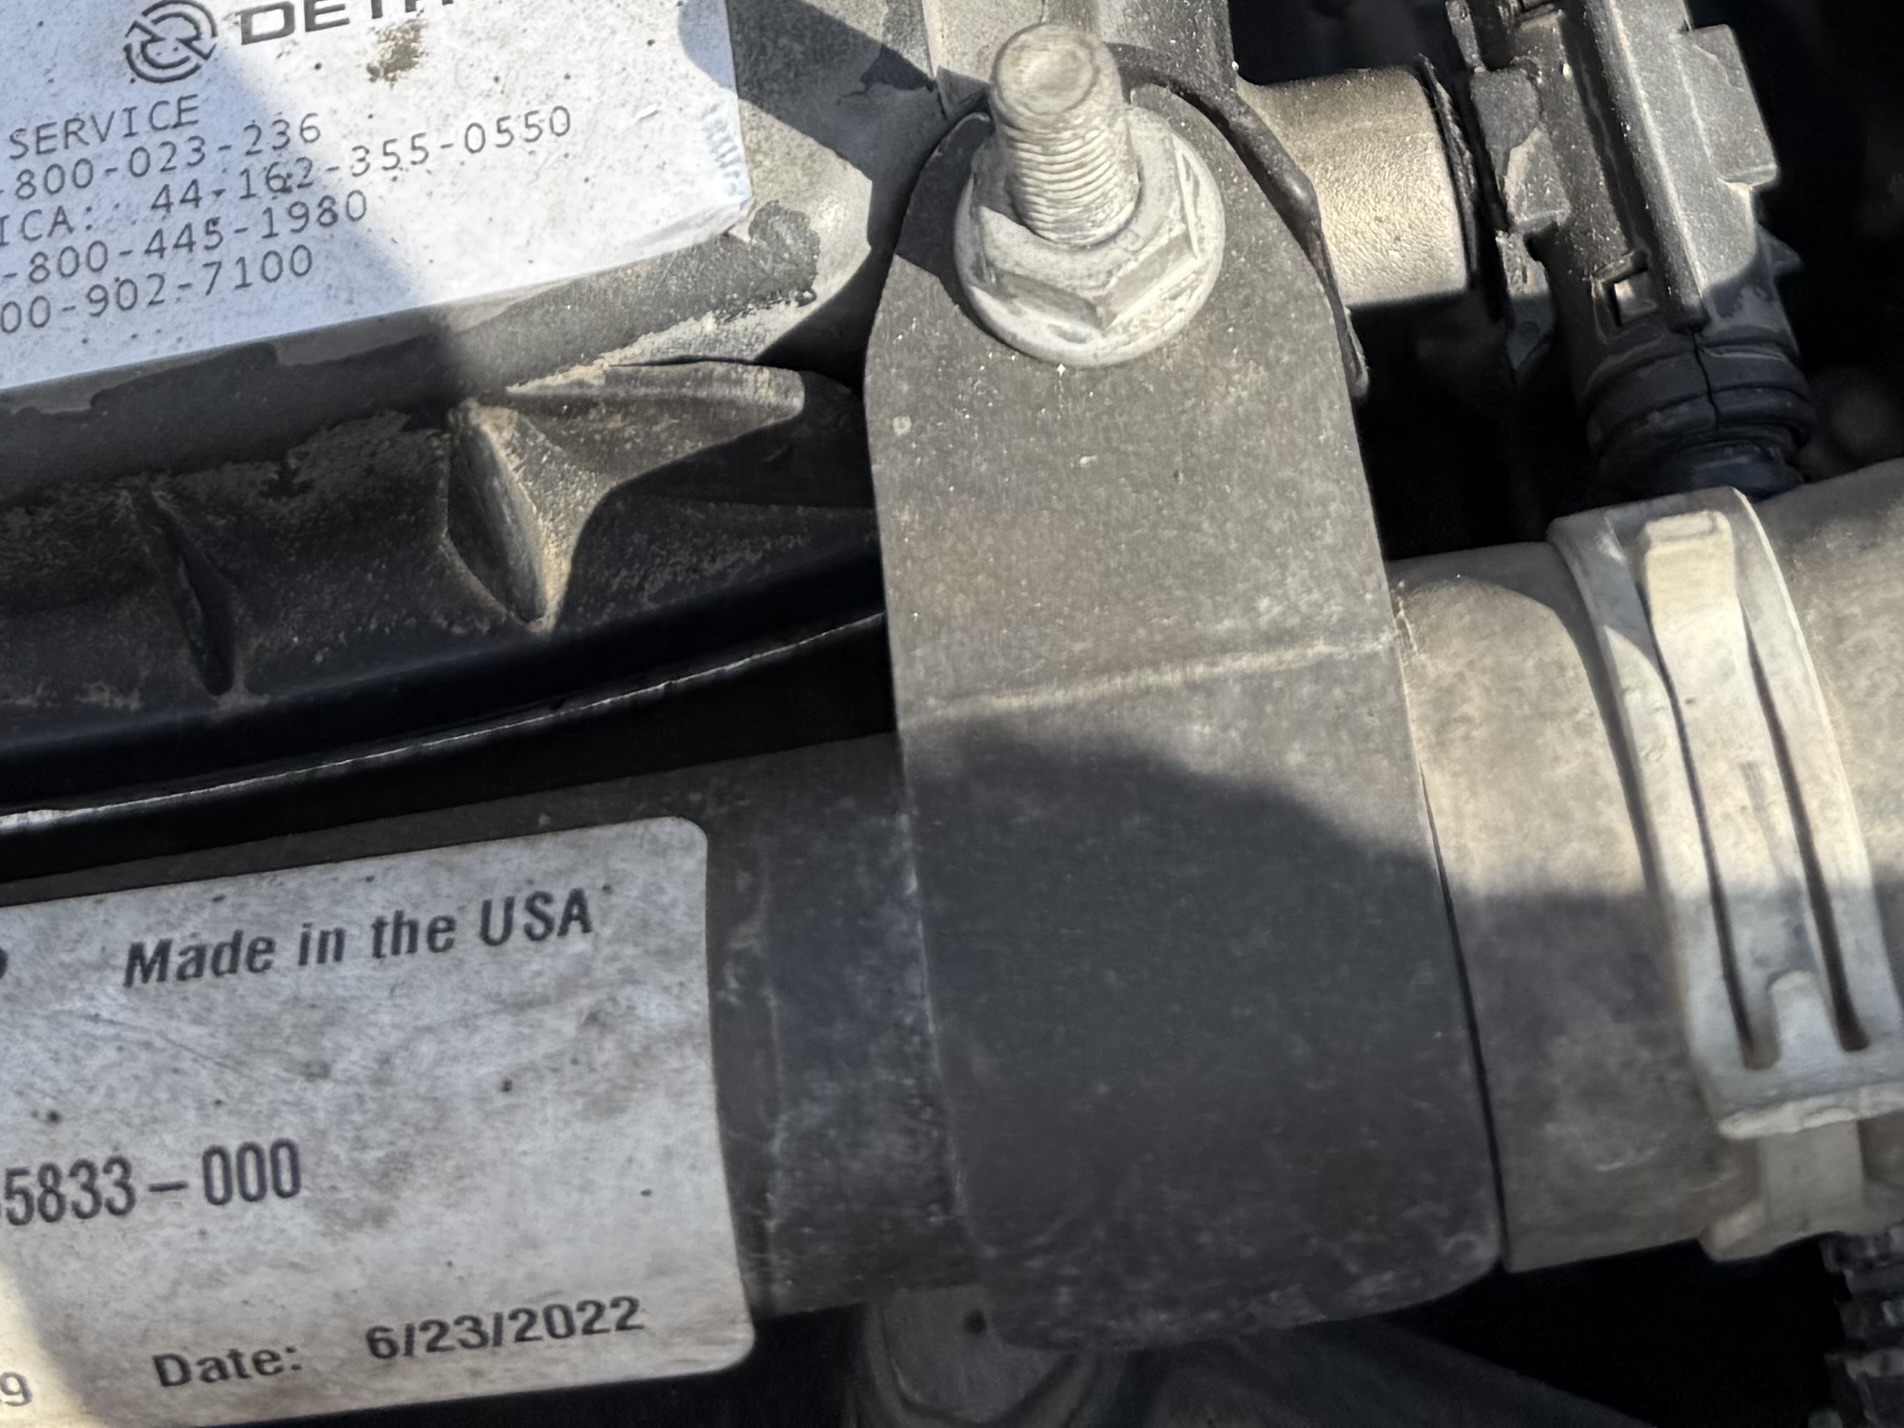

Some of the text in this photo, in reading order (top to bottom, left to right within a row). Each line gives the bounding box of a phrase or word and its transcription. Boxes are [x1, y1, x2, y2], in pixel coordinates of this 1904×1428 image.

[8, 91, 202, 163] SERVICE
[122, 892, 596, 989] Made in the USA
[152, 1293, 645, 1390] Date: 6/23/2022
